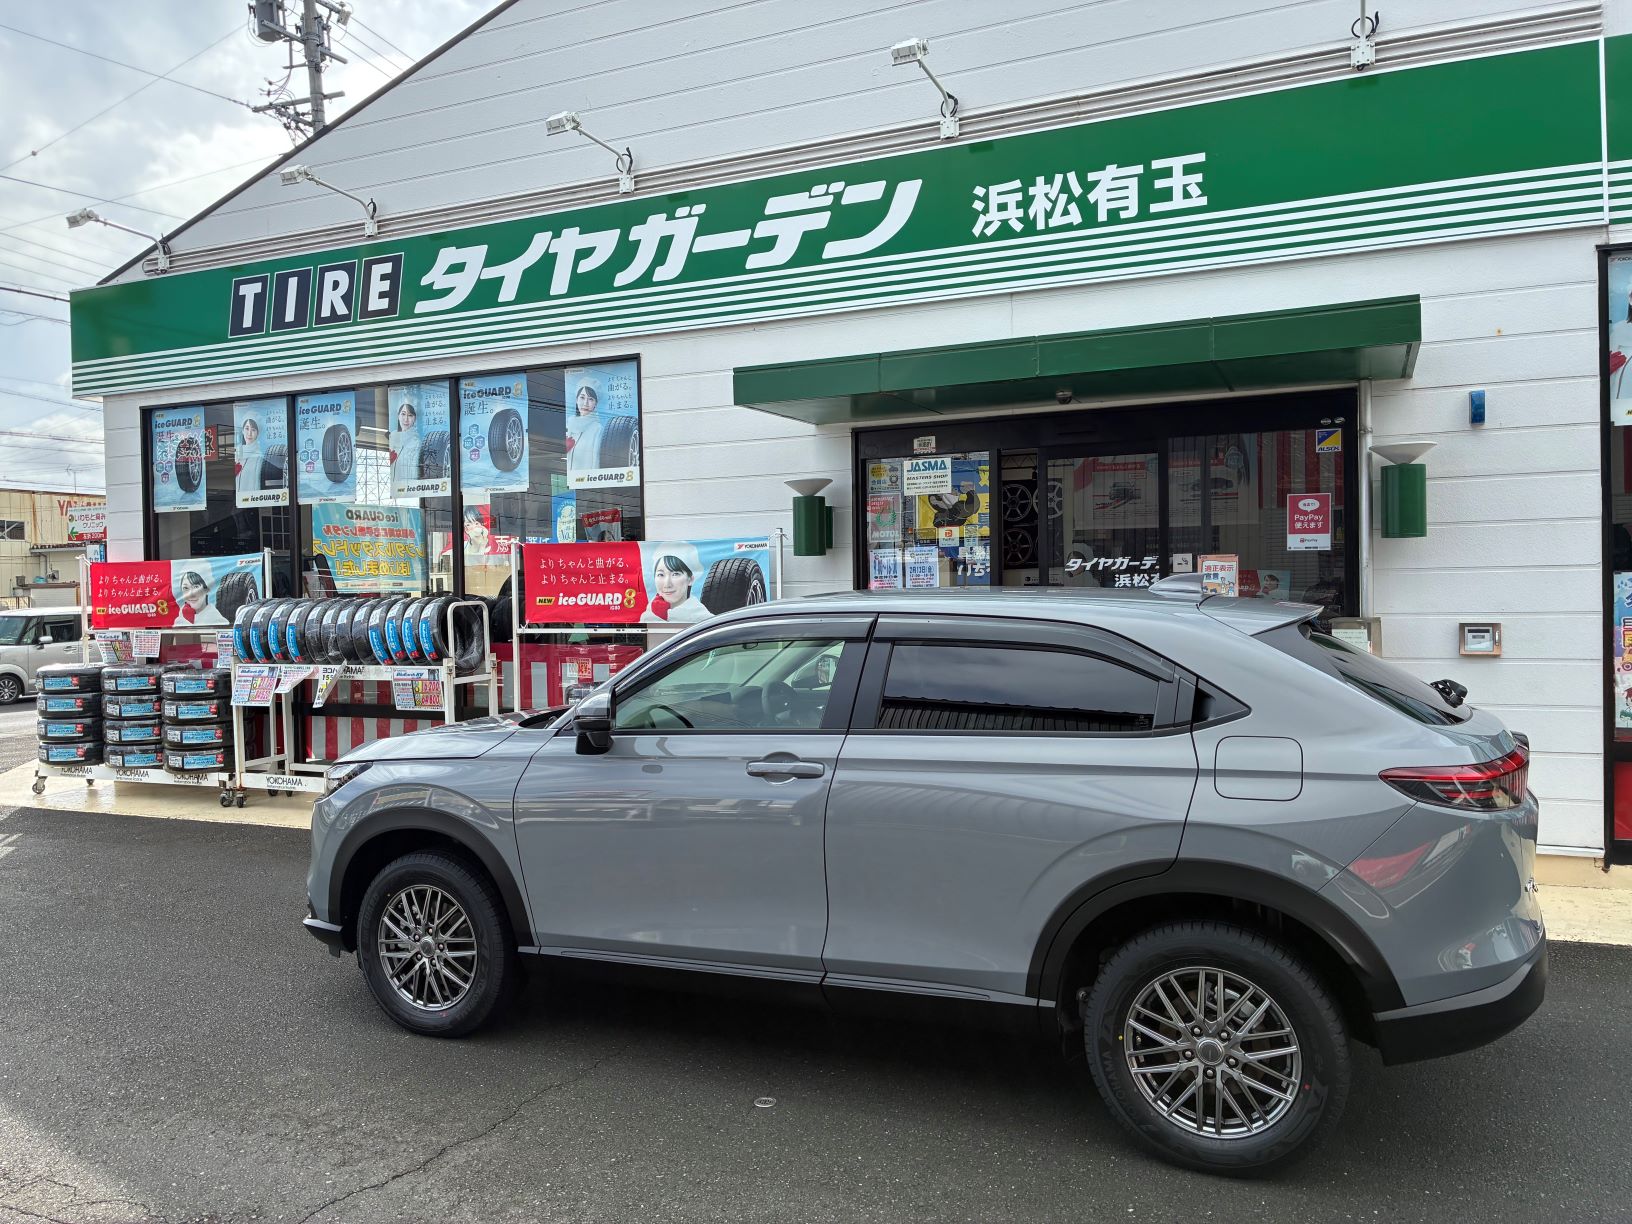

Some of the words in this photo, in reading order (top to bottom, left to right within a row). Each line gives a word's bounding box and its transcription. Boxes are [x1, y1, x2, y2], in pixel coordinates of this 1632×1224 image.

[414, 179, 923, 314] タイヤガーデン
[971, 152, 1208, 238] 浜松有玉
[236, 260, 397, 330] TIRE
[463, 386, 512, 399] iceGUARD
[608, 383, 632, 392] 曲がる。
[299, 403, 342, 415] iceGUARD
[608, 402, 633, 410] 止まる。
[154, 417, 193, 430] iceGUARD
[906, 459, 948, 473] JASMA
[587, 473, 625, 482] iceGUARD
[406, 483, 440, 492] iceGUARD
[250, 493, 281, 502] iceGUARD
[1294, 514, 1324, 522] PayPay
[1294, 521, 1324, 529] 使えます
[871, 530, 899, 539] MOTUL
[1064, 556, 1160, 571] タイヤガーデ
[1204, 564, 1234, 572] 適正表示
[538, 597, 553, 605] NEW
[557, 592, 623, 606] iceGUARD
[623, 588, 637, 609] 8
[108, 602, 157, 614] iceGUARD
[157, 599, 169, 615] 8
[116, 768, 150, 778] YOKOHAMA
[266, 776, 303, 786] YOKOHAMA
